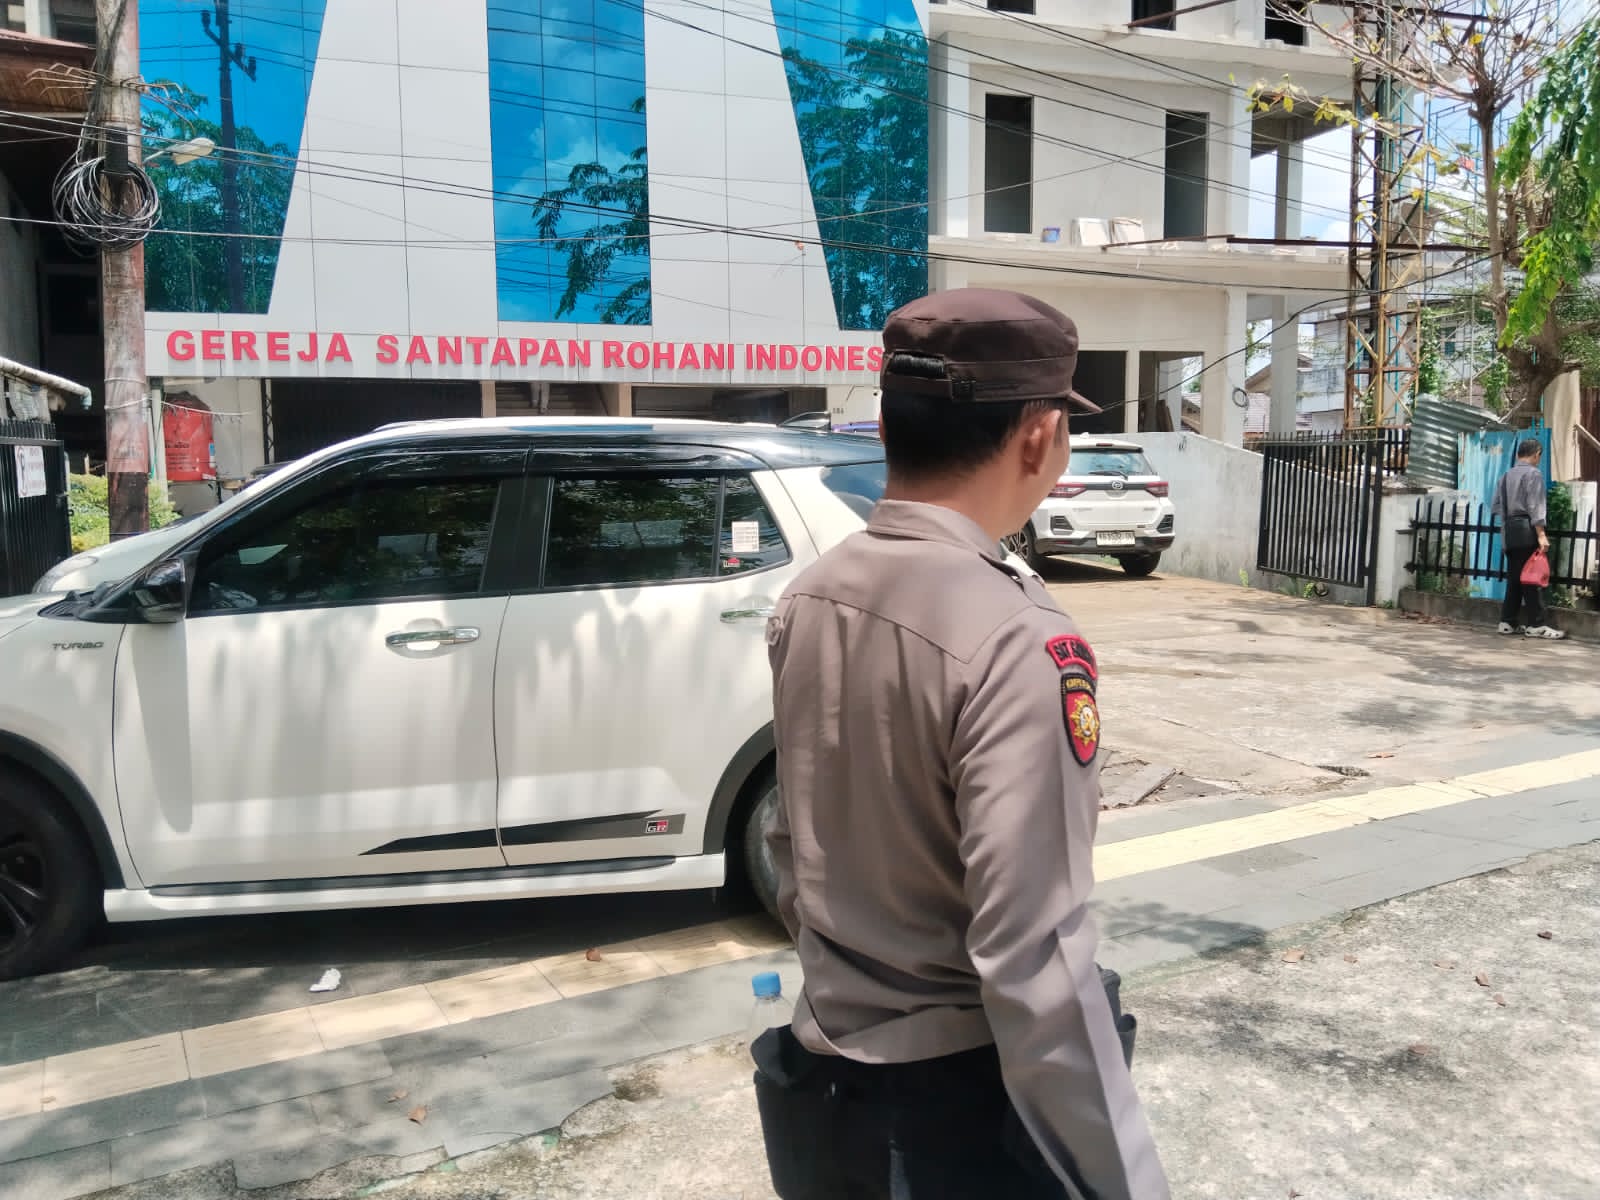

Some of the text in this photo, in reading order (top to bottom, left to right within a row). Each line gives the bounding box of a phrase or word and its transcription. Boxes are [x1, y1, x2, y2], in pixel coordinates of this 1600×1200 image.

[166, 329, 884, 372] GEREJA SANTAPAN ROHANI INDONES
[52, 641, 104, 650] TURBO
[647, 823, 668, 832] GR
